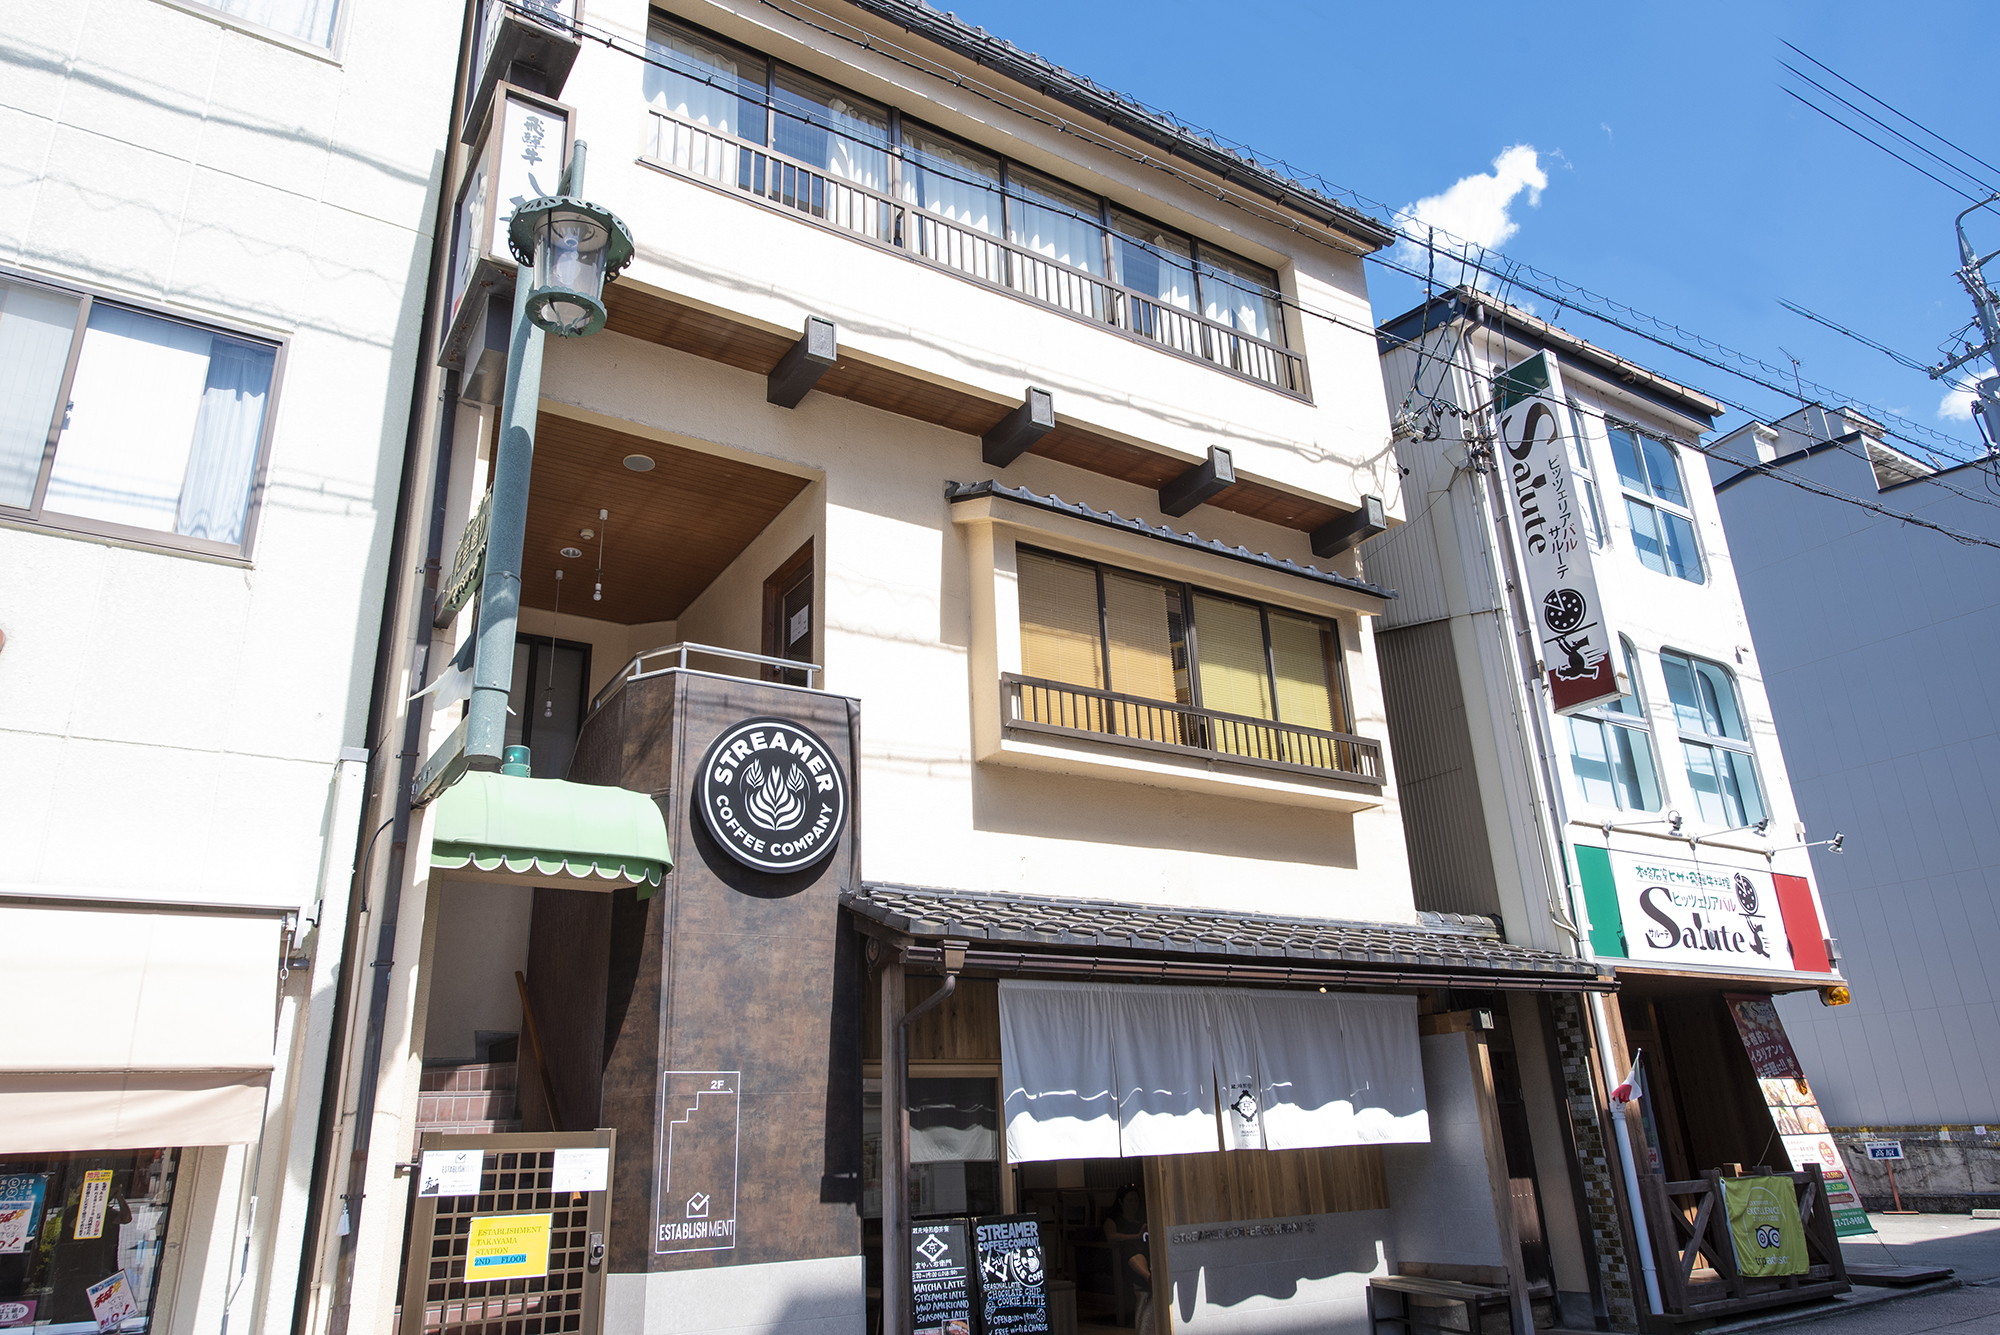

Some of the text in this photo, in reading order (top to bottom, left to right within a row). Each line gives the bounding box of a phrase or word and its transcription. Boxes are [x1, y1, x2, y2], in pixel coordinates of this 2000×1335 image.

[1502, 402, 1559, 558] Salute
[1548, 454, 1578, 554] ピッツェリアバル
[1548, 527, 1570, 581] サルーテ
[714, 731, 834, 794] STREAMER
[716, 794, 833, 857] COFFEE COMPANY
[1672, 892, 1736, 912] ピッツェリアバル
[1639, 886, 1747, 953] Salute
[1648, 928, 1669, 939] サルーテ
[1751, 1044, 1785, 1063] イタリアンを
[710, 1080, 725, 1090] 2F
[1747, 1206, 1780, 1216] EXCELLENCE
[478, 1226, 542, 1237] ESTABLISHMENT
[976, 1221, 1039, 1242] STREAMER
[476, 1237, 518, 1246] TAKAYAMA
[978, 1236, 1040, 1252] COFFEE COMPANY
[475, 1247, 509, 1256] STATION
[474, 1254, 527, 1266] 2ND FLOOR
[913, 1280, 966, 1294] MATCHA LATTE
[983, 1282, 1007, 1291] SEASONAL
[987, 1287, 1042, 1300] CHOCOLATE CHIP
[949, 1290, 968, 1300] LATTE
[997, 1296, 1046, 1306] COOKIE LATTE
[917, 1310, 970, 1324] SEASONAL LATTE
